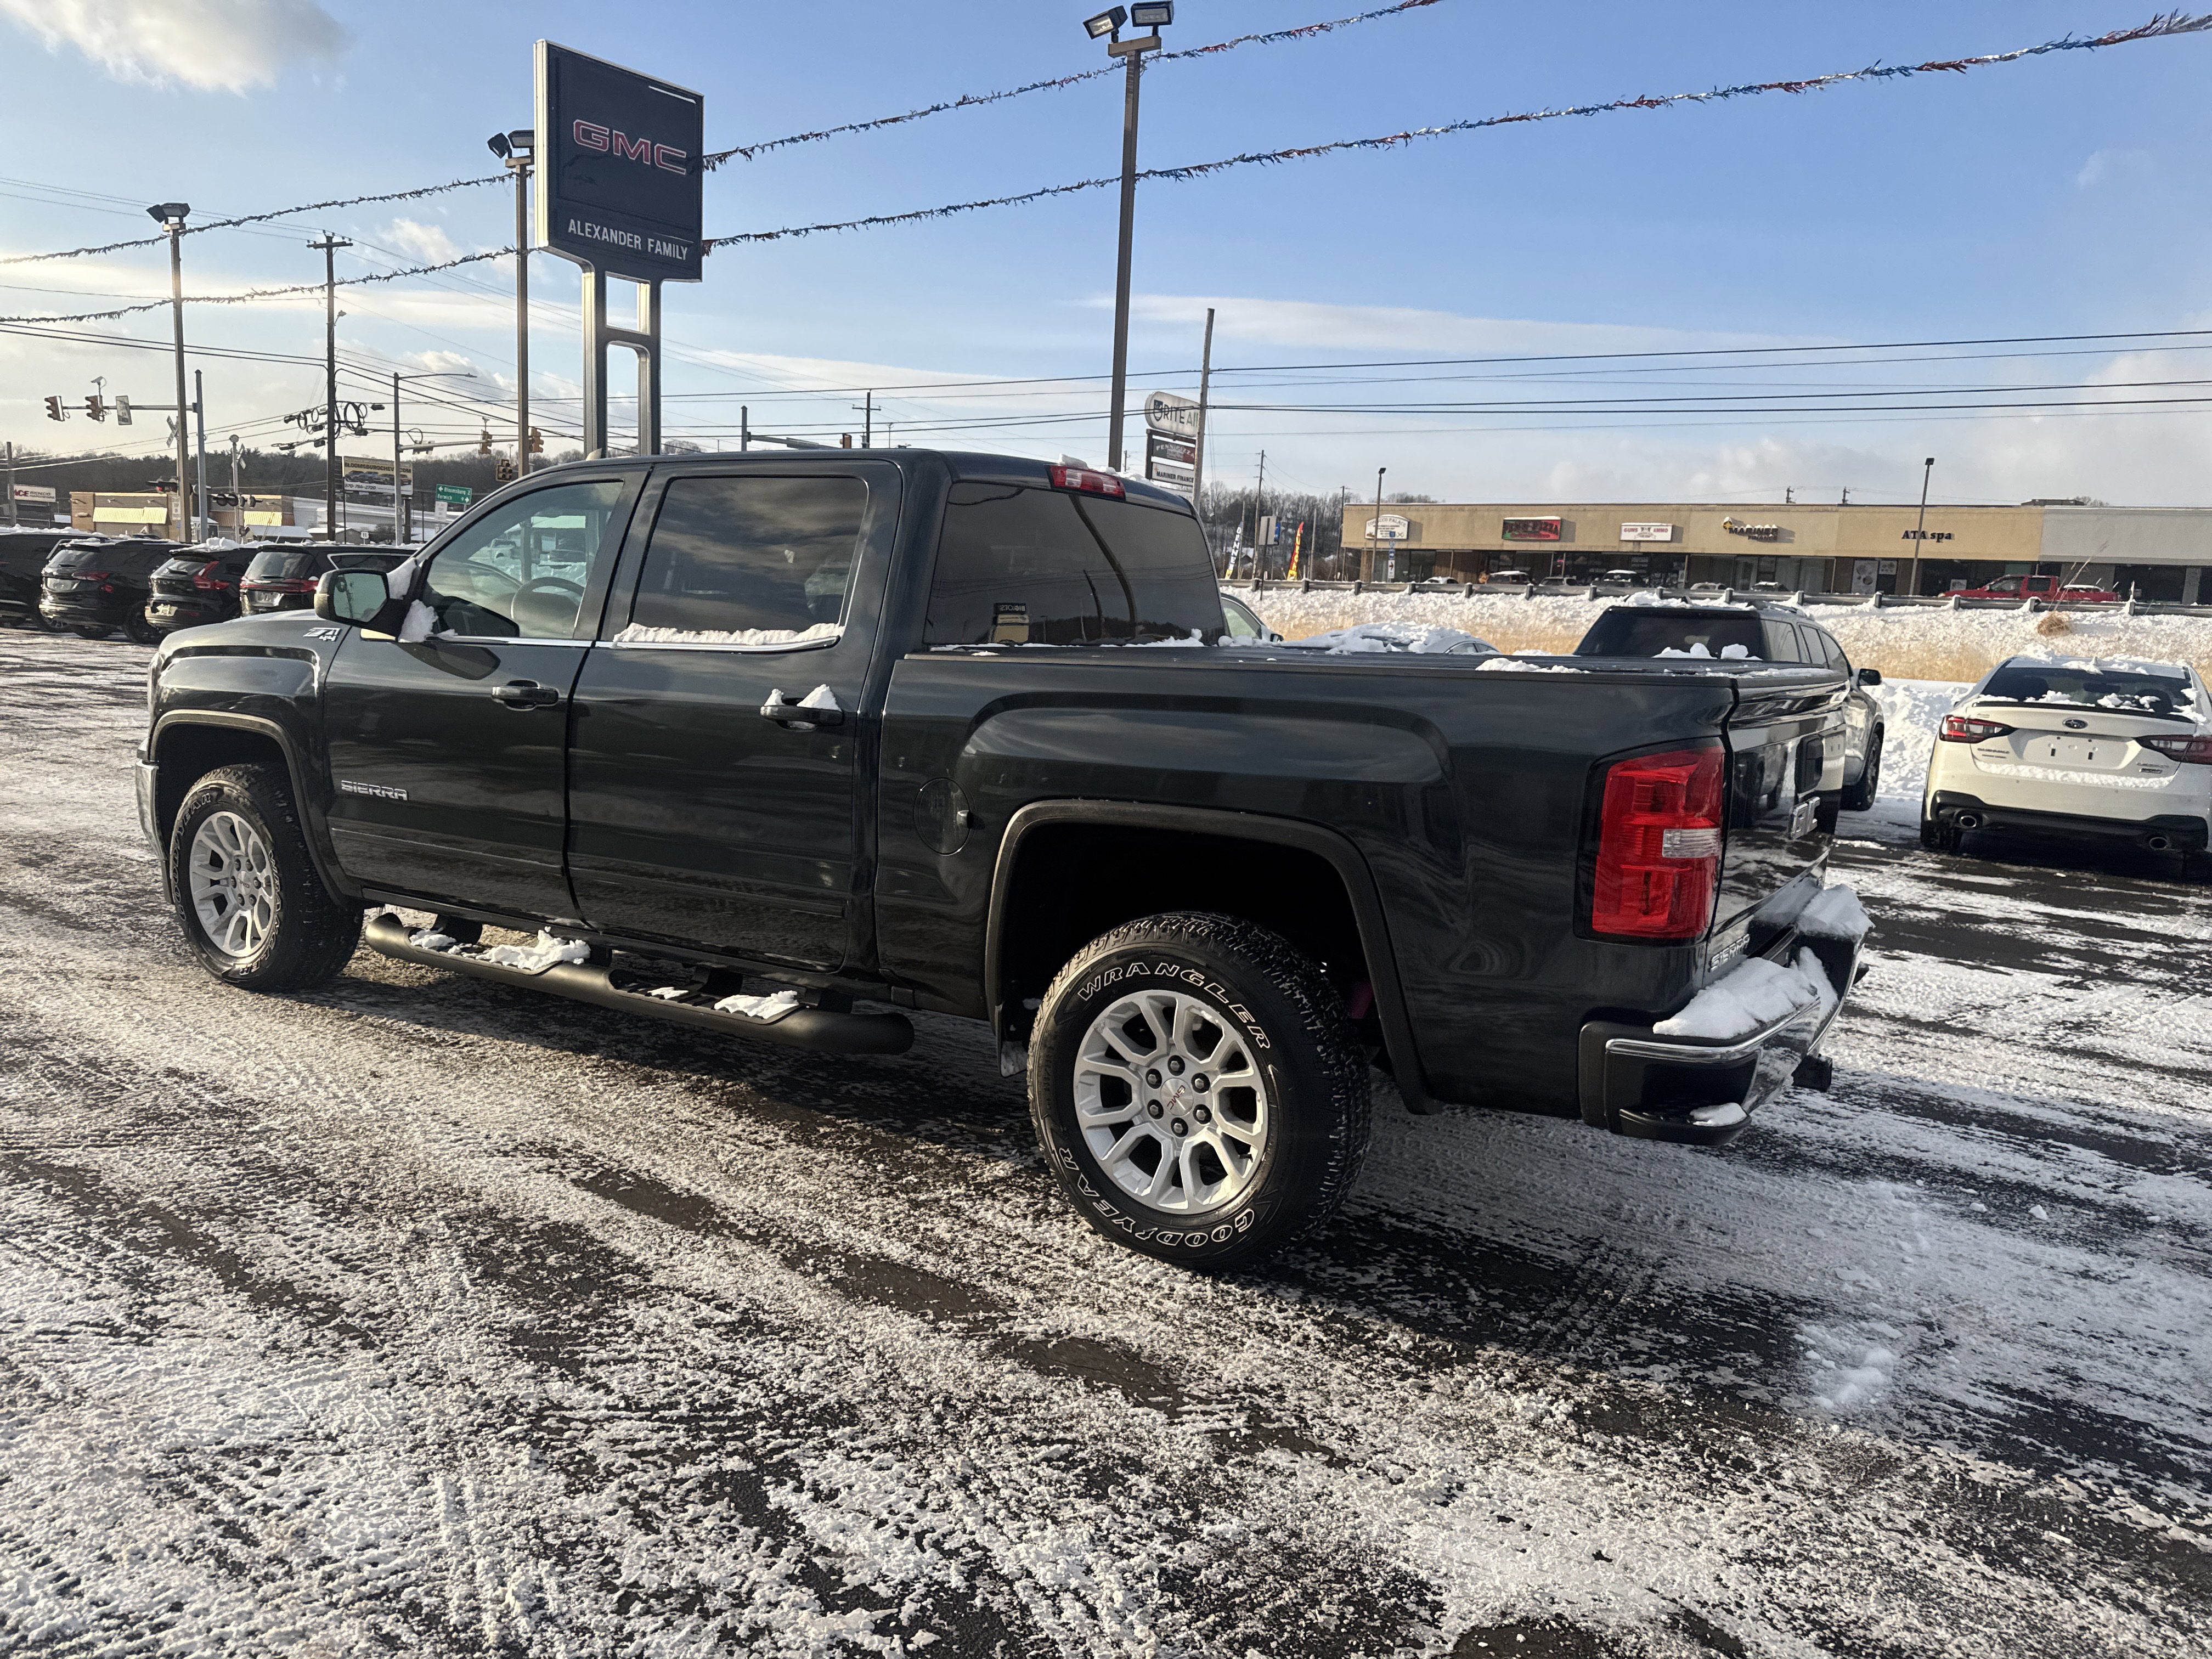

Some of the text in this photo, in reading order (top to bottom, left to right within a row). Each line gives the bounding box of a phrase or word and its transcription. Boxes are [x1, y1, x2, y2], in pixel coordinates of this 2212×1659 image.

[573, 119, 687, 176] GMC
[568, 219, 688, 261] ALEXANDER FAMILY
[1164, 404, 1185, 424] RITE
[1156, 471, 1194, 483] MARINER FINANCE
[1901, 530, 1951, 543] ATA spa
[341, 780, 408, 800] SIERRA
[1711, 933, 1750, 970] SIERRA
[1077, 961, 1271, 1049] WRANGLER
[1166, 1085, 1186, 1110] GMC
[1059, 1147, 1255, 1248] GOODYEAR
